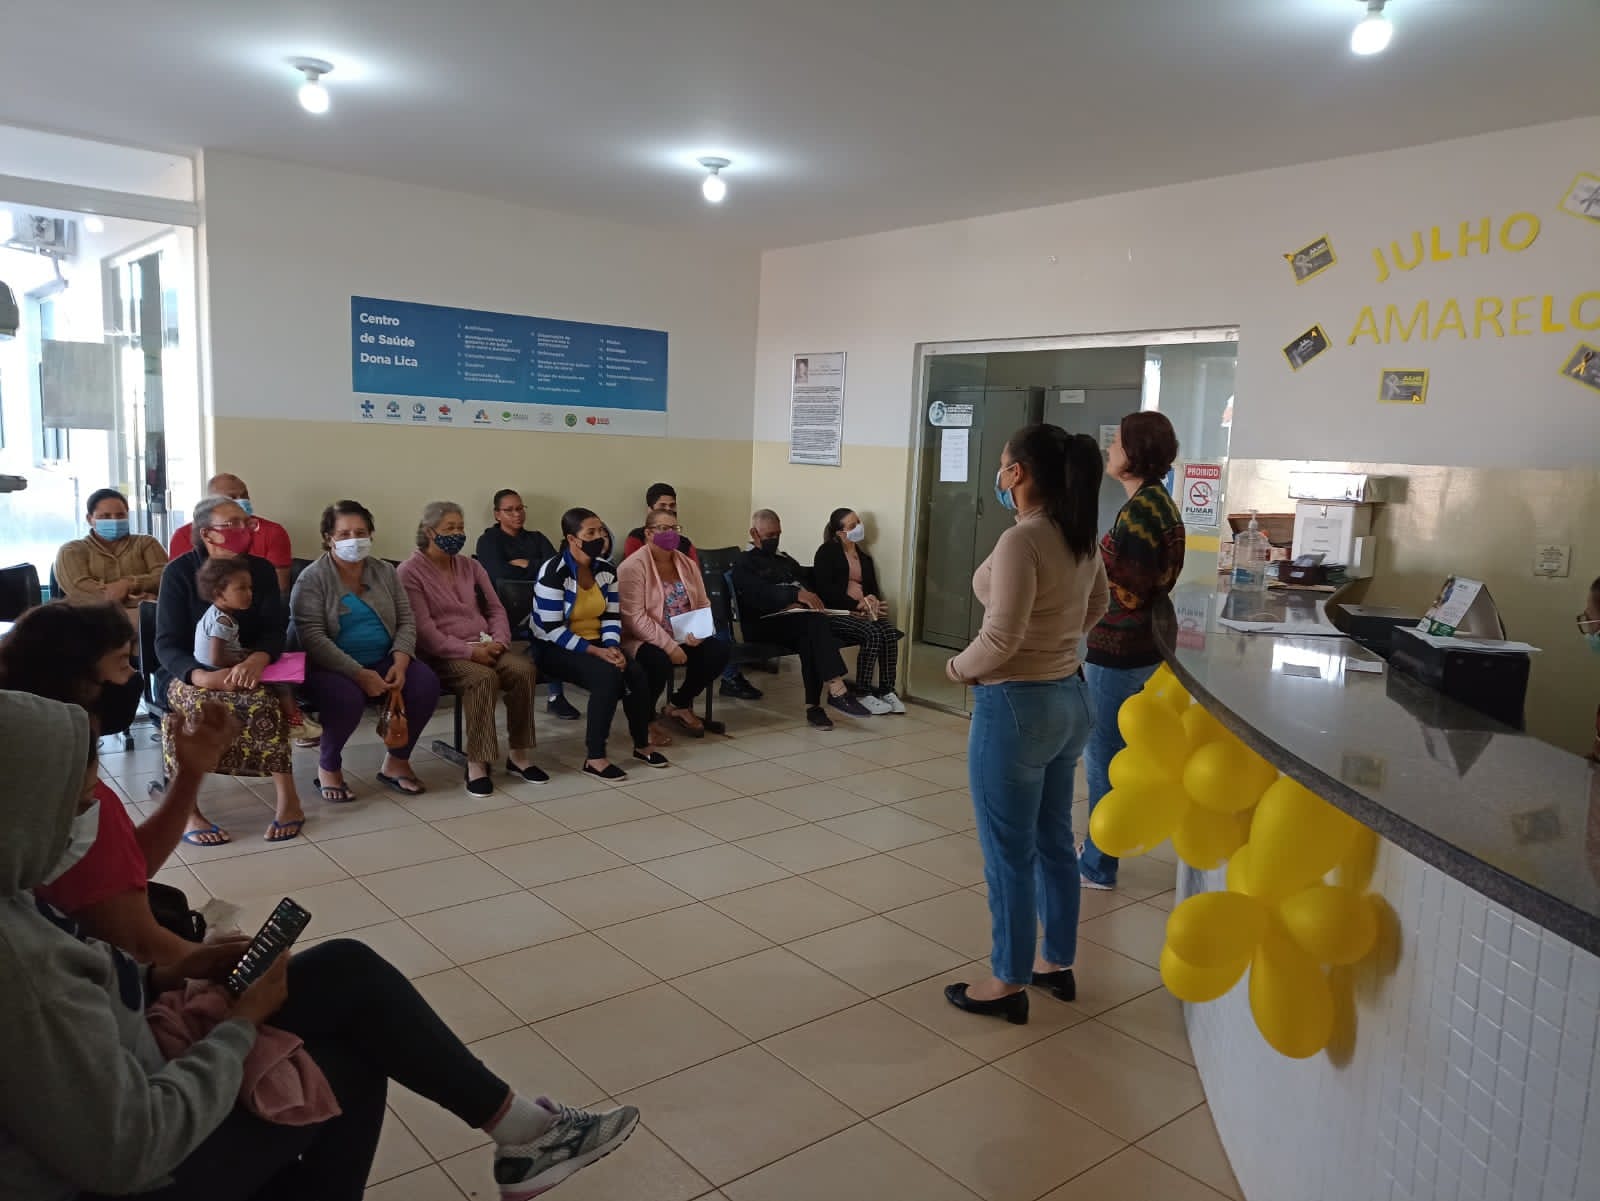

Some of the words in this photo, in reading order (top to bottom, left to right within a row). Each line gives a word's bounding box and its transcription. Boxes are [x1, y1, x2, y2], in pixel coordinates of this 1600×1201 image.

[1372, 211, 1541, 283] JULHO
[359, 312, 400, 327] Centro
[1347, 291, 1600, 346] AMARELO
[359, 332, 375, 344] de
[378, 334, 415, 348] Saúde
[360, 352, 391, 365] Dona
[394, 355, 418, 367] Lica
[1187, 466, 1218, 477] PROIBIDO
